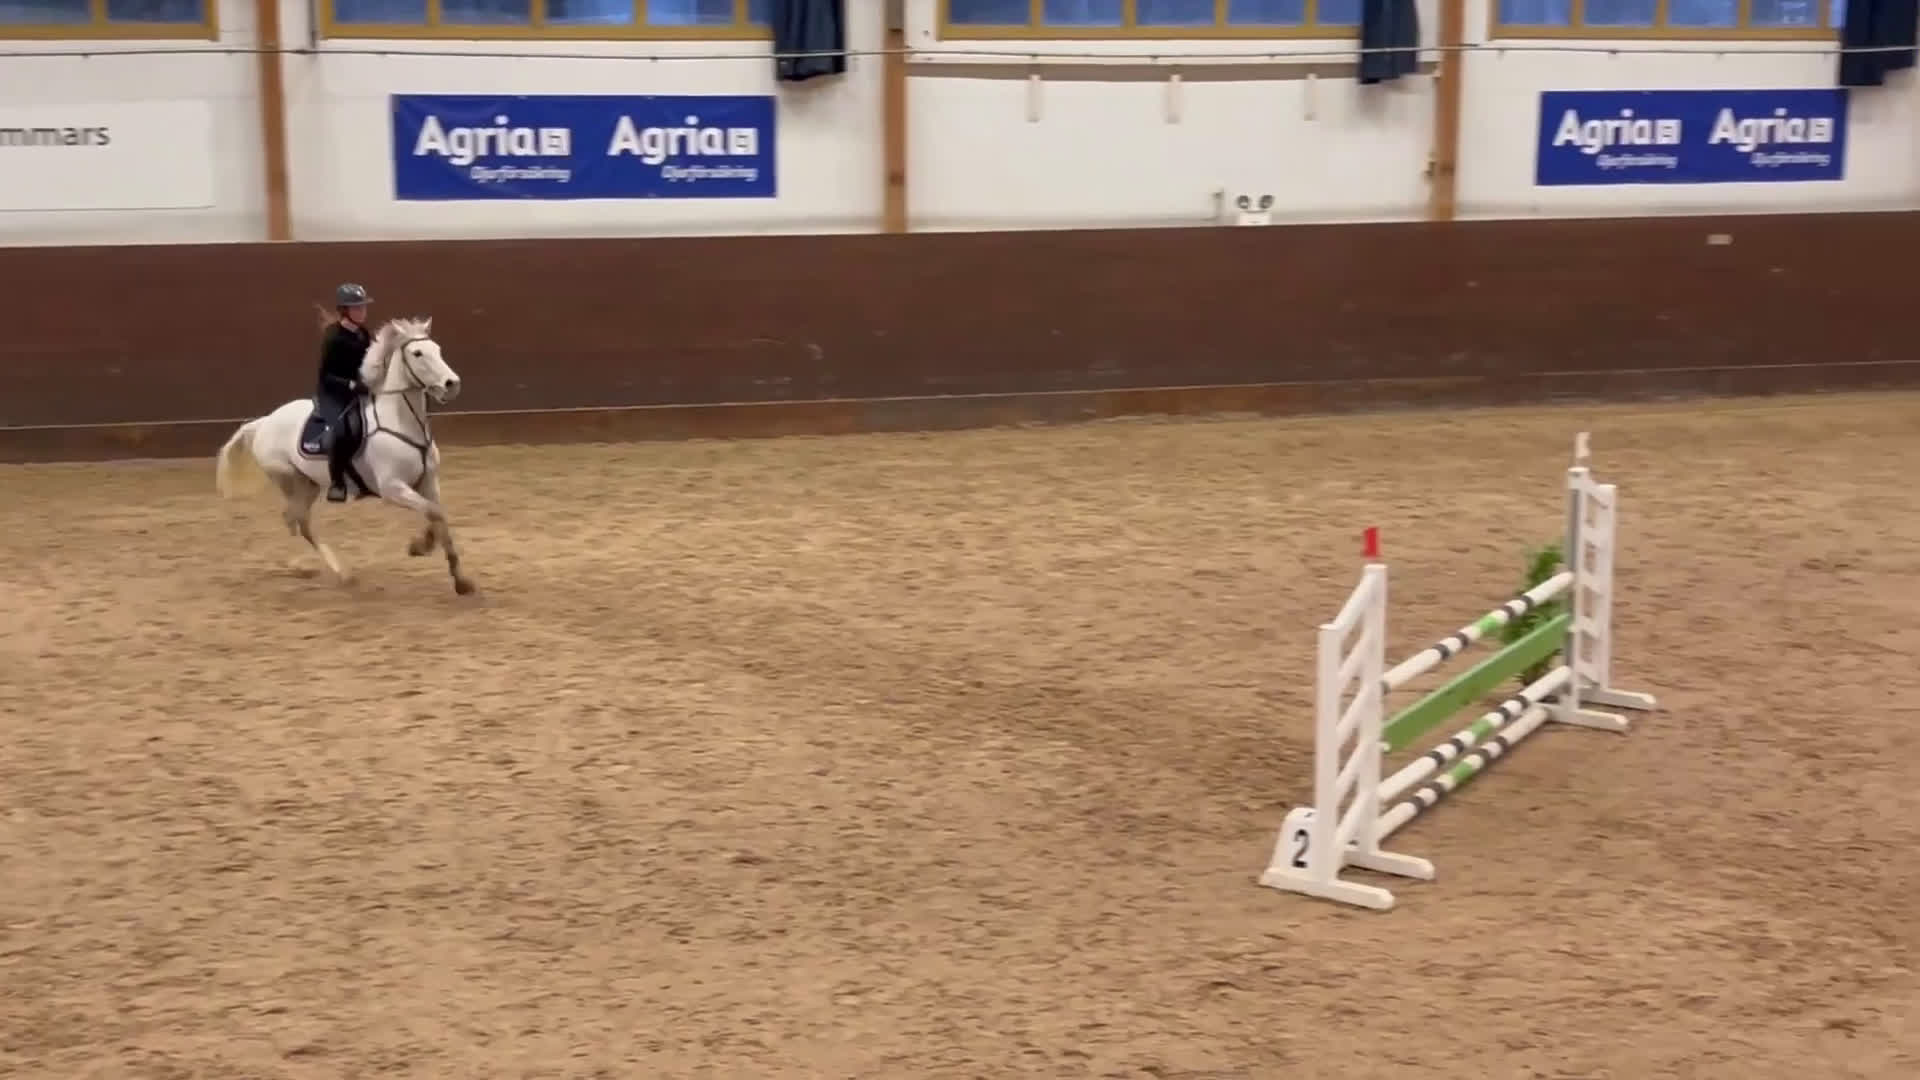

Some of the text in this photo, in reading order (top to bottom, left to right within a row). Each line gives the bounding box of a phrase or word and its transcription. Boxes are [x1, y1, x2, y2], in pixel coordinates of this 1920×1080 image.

[413, 115, 537, 166] Agria
[607, 115, 727, 166] Agria
[1552, 108, 1653, 154] Agria
[1708, 107, 1809, 152] Agria
[1291, 829, 1310, 868] 2
